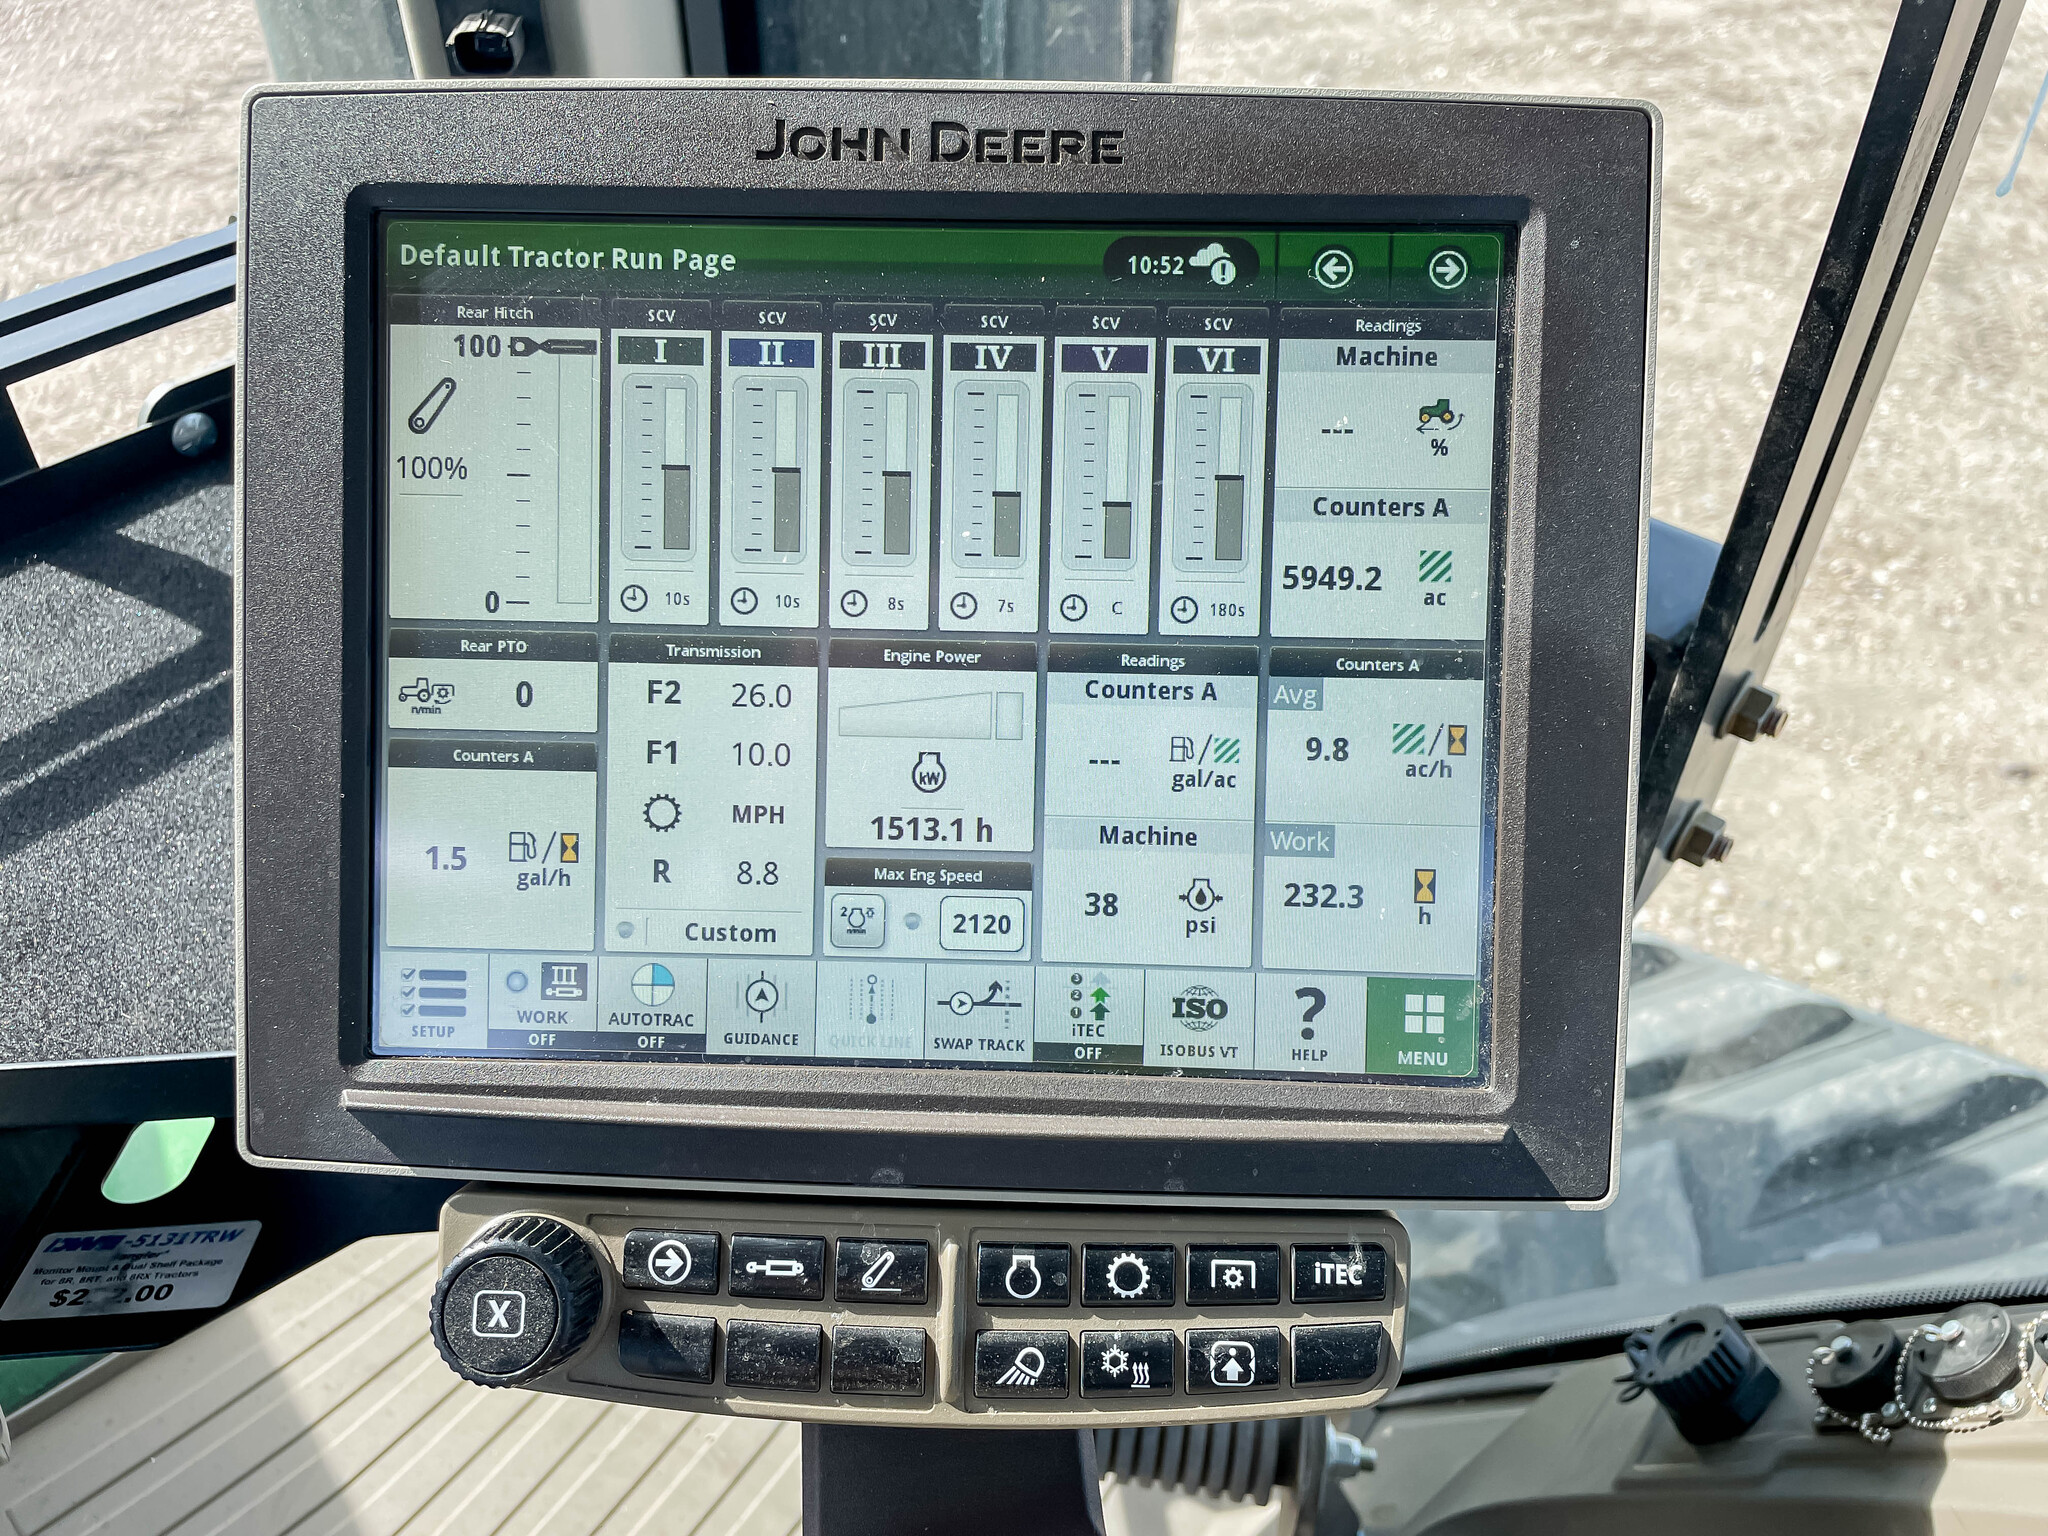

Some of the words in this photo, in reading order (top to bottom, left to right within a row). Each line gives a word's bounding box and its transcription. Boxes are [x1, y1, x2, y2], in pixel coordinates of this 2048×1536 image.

[756, 119, 911, 162] JOHN
[930, 121, 1125, 165] DEERE
[400, 244, 500, 267] Default
[509, 246, 604, 269] Tractor
[612, 249, 662, 270] Run
[673, 249, 736, 277] Page
[1128, 255, 1185, 275] 10:52
[457, 306, 488, 319] Rear
[494, 306, 534, 320] Hitch
[647, 309, 676, 323] SCV
[758, 311, 786, 325] SCV
[869, 314, 897, 327] SCV
[981, 315, 1008, 328] SCV
[1092, 316, 1120, 330] SCV
[1204, 318, 1232, 331] SCV
[1355, 319, 1422, 335] Readings
[453, 334, 501, 357] 100
[654, 339, 668, 363] I
[759, 341, 785, 365] II
[863, 343, 902, 368] III
[974, 345, 1013, 370] IV
[1092, 347, 1118, 371] V
[1198, 348, 1235, 373] VI
[1337, 346, 1438, 366] Machine
[1431, 439, 1448, 456] %
[396, 455, 467, 480] 100%
[1314, 497, 1424, 517] Counters
[1433, 499, 1449, 517] A
[1282, 565, 1383, 591] 5949.2
[485, 591, 500, 613] 0
[665, 592, 690, 606] 10s
[776, 594, 800, 609] 10s
[888, 597, 904, 612] 8s
[998, 599, 1014, 613] 7s
[1424, 592, 1446, 606] ac
[1112, 601, 1122, 615] C
[1210, 602, 1245, 617] 180s
[461, 640, 493, 653] Rear
[497, 641, 528, 654] PTO
[666, 644, 761, 659] Transmission
[883, 649, 931, 665] Engine
[936, 650, 981, 665] Power
[1121, 654, 1185, 669] Readings
[1336, 658, 1404, 672] Counters
[1408, 660, 1420, 672] A
[516, 681, 533, 707] 0
[647, 680, 682, 705] F2
[732, 683, 791, 708] 26.0
[1085, 680, 1194, 700] Counters
[1201, 683, 1218, 701] A
[1273, 685, 1317, 709] Avg
[411, 705, 441, 715] n/min
[453, 749, 520, 763] Counters
[522, 750, 534, 763] A
[647, 740, 678, 764] F1
[732, 742, 791, 767] 10.0
[1306, 737, 1349, 762] 9.8
[1405, 760, 1452, 778] ac/h
[919, 771, 940, 785] kW
[1171, 770, 1237, 792] gal/ac
[732, 805, 784, 824] MPH
[871, 816, 964, 843] 1513.1
[977, 817, 993, 842] h
[1099, 825, 1198, 846] Machine
[1270, 830, 1330, 851] Work
[425, 846, 467, 871] 1.5
[516, 869, 571, 891] gal/h
[653, 859, 672, 883] R
[736, 861, 779, 885] 8.8
[874, 868, 905, 882] Max
[910, 869, 936, 884] Eng
[940, 869, 983, 885] Speed
[1284, 883, 1364, 909] 232.3
[1084, 893, 1118, 917] 38
[952, 913, 1012, 934] 2120
[1419, 907, 1431, 925] h
[685, 923, 777, 943] Custom
[1186, 916, 1216, 939] psi
[517, 1010, 568, 1025] WORK
[1172, 998, 1228, 1020] ISO
[608, 1012, 694, 1027] AUTOTRAC
[411, 1025, 455, 1038] SETUP
[724, 1032, 799, 1046] GUIDANCE
[1072, 1024, 1105, 1037] iTEC
[528, 1033, 556, 1046] OFF
[637, 1035, 665, 1049] OFF
[934, 1037, 973, 1050] SWAP
[978, 1038, 1025, 1051] TRACK
[1074, 1047, 1102, 1060] OFF
[1160, 1044, 1215, 1057] ISOBUS
[1220, 1046, 1238, 1058] VT
[1292, 1049, 1328, 1062] HELP
[1398, 1051, 1448, 1066] MENU
[76, 1265, 109, 1273] Mount
[149, 1259, 178, 1269] Shelf
[179, 1258, 224, 1268] Package
[1315, 1261, 1362, 1286] iTEC
[40, 1278, 54, 1286] for
[155, 1270, 199, 1280] Tractors
[49, 1284, 174, 1308] $2.00
